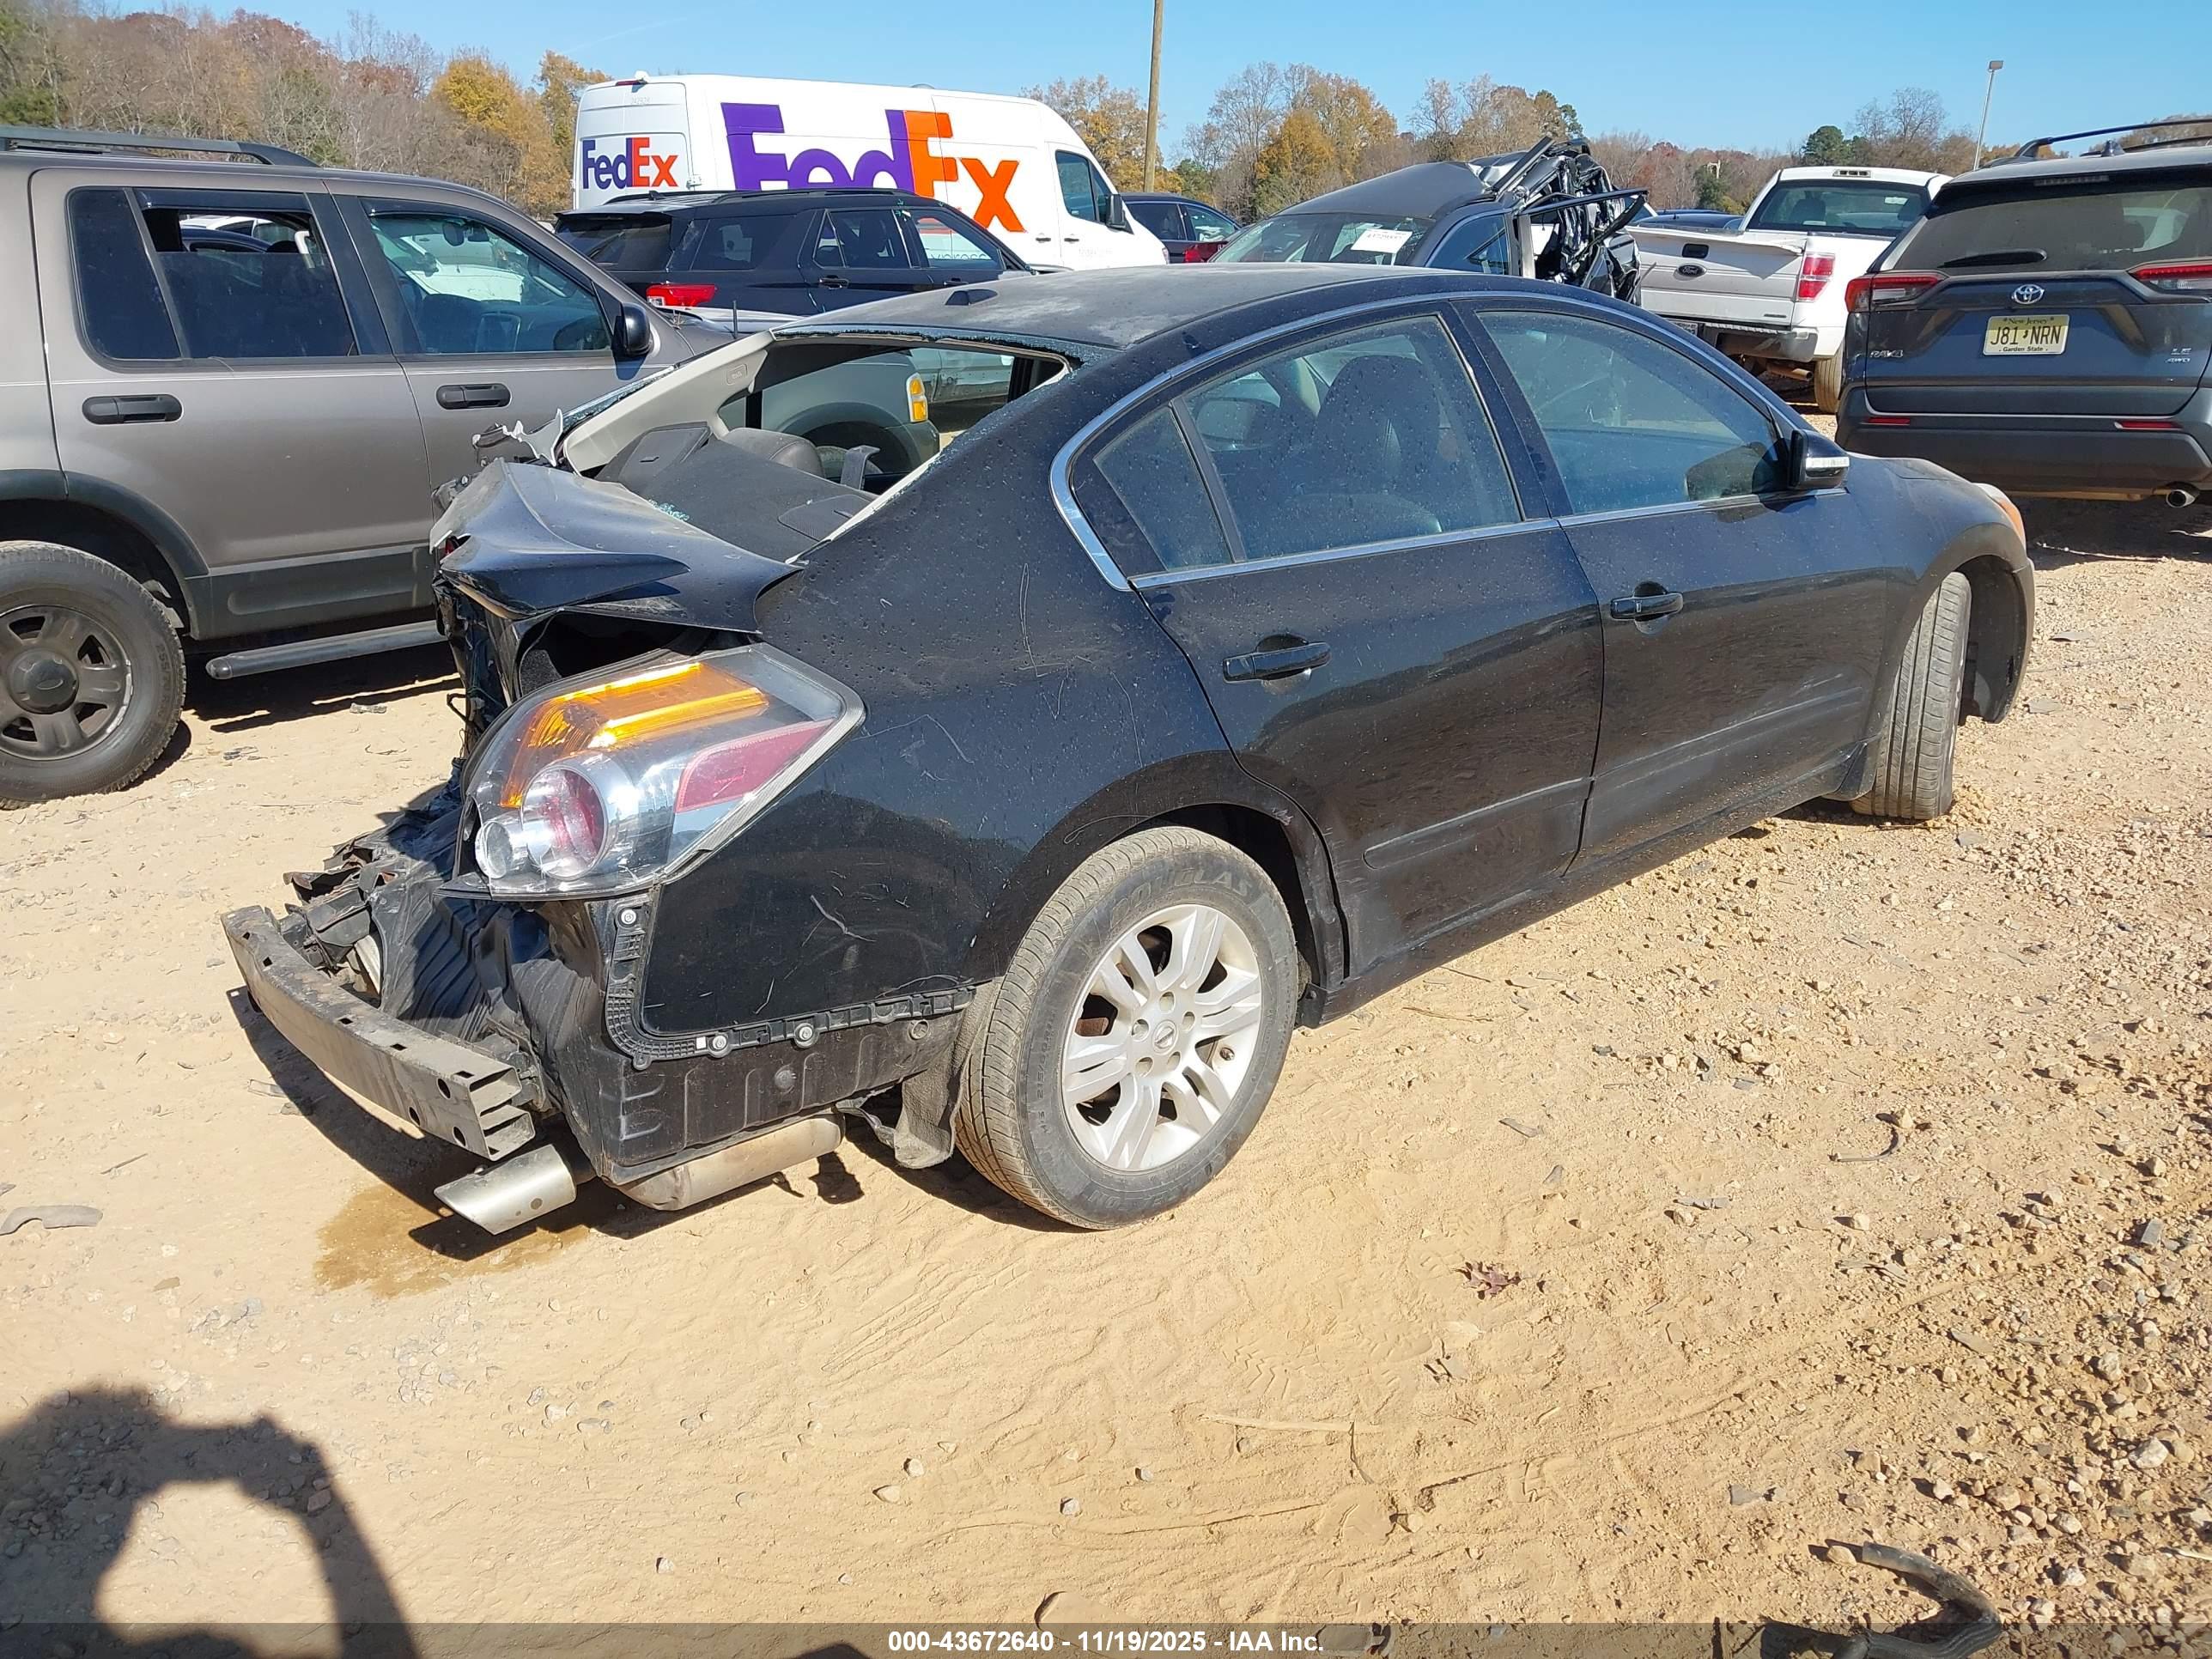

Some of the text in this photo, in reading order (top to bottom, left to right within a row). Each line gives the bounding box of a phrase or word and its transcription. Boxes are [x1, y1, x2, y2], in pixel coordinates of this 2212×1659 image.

[582, 137, 679, 190] FedEx
[720, 102, 1028, 233] FedEx
[1990, 325, 2062, 345] J81 NRN
[2027, 317, 2048, 325] Jersey
